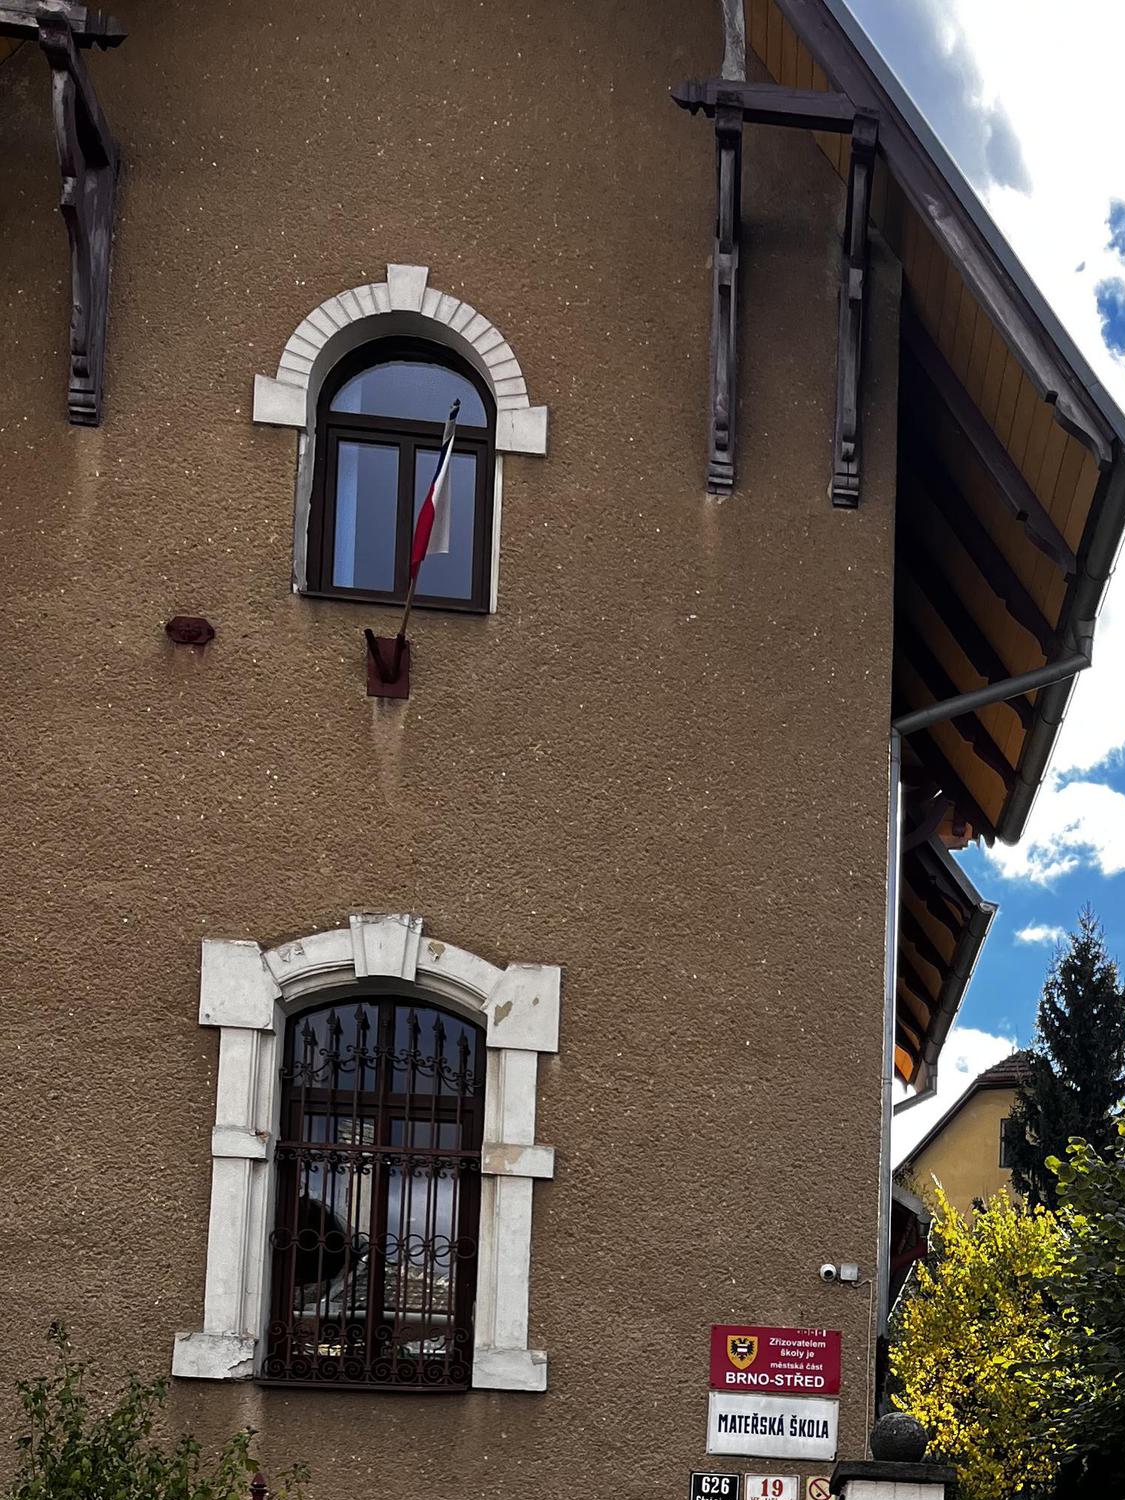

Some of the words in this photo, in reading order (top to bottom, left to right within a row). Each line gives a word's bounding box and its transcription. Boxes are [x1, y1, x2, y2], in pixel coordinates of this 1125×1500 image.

[780, 1348, 804, 1359] školy
[805, 1350, 815, 1360] je
[770, 1361, 804, 1370] městská
[805, 1363, 823, 1371] část
[725, 1372, 825, 1388] BRNO-STŘED
[717, 1412, 785, 1437] MATEŘSKÁ
[789, 1414, 829, 1439] ŠKOLA
[701, 1476, 730, 1495] 626
[761, 1478, 784, 1497] 19
